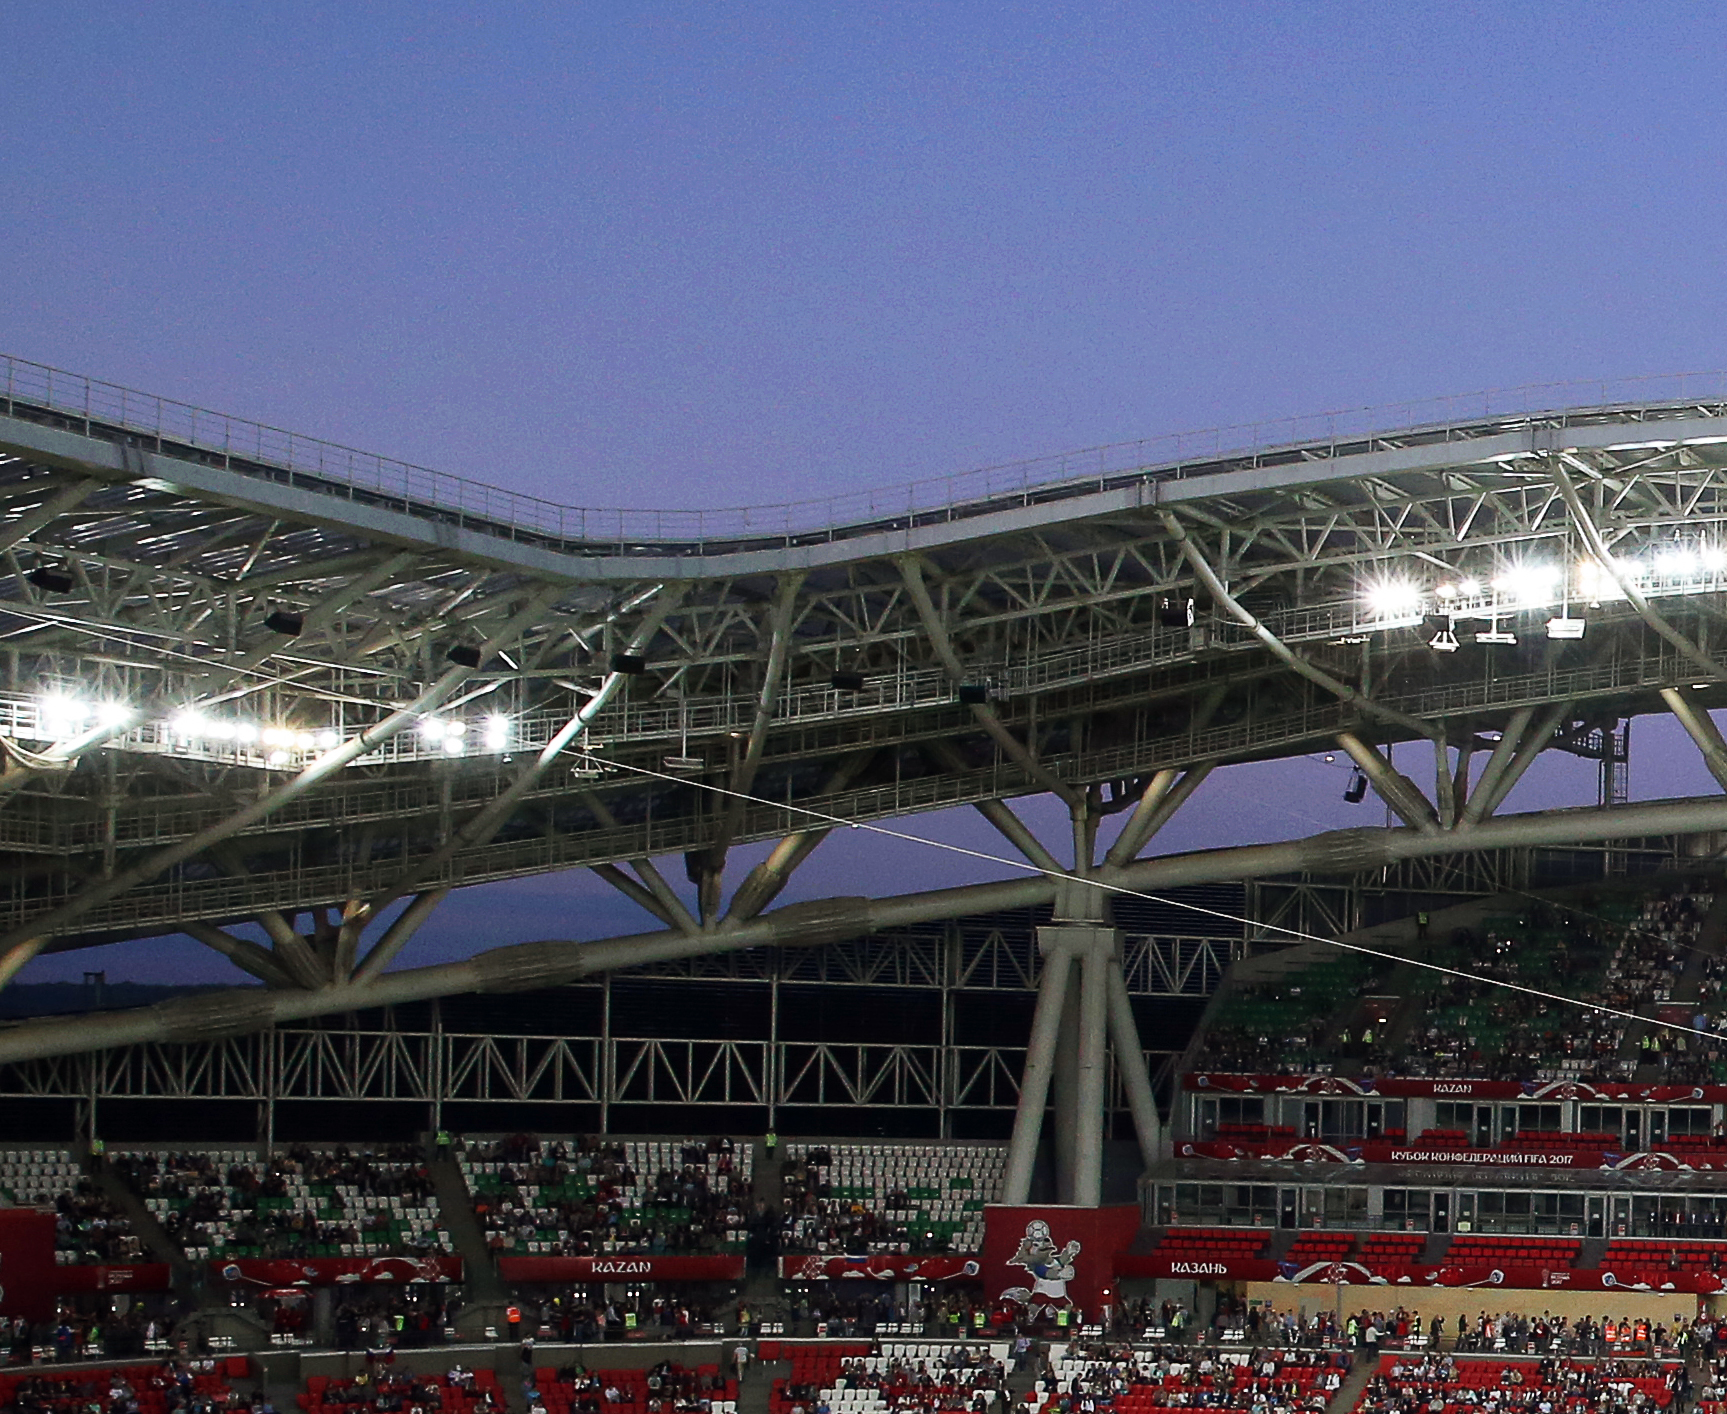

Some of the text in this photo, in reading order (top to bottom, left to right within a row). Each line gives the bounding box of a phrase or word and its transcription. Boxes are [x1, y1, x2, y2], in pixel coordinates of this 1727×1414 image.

[1433, 1083, 1472, 1094] KAZAN
[1391, 1151, 1574, 1165] КУБОК КОНФЕДЕРАЦИЙ FIFA 2017
[591, 1261, 651, 1273] KAZAN
[1171, 1262, 1228, 1274] КАЗАНЬ
